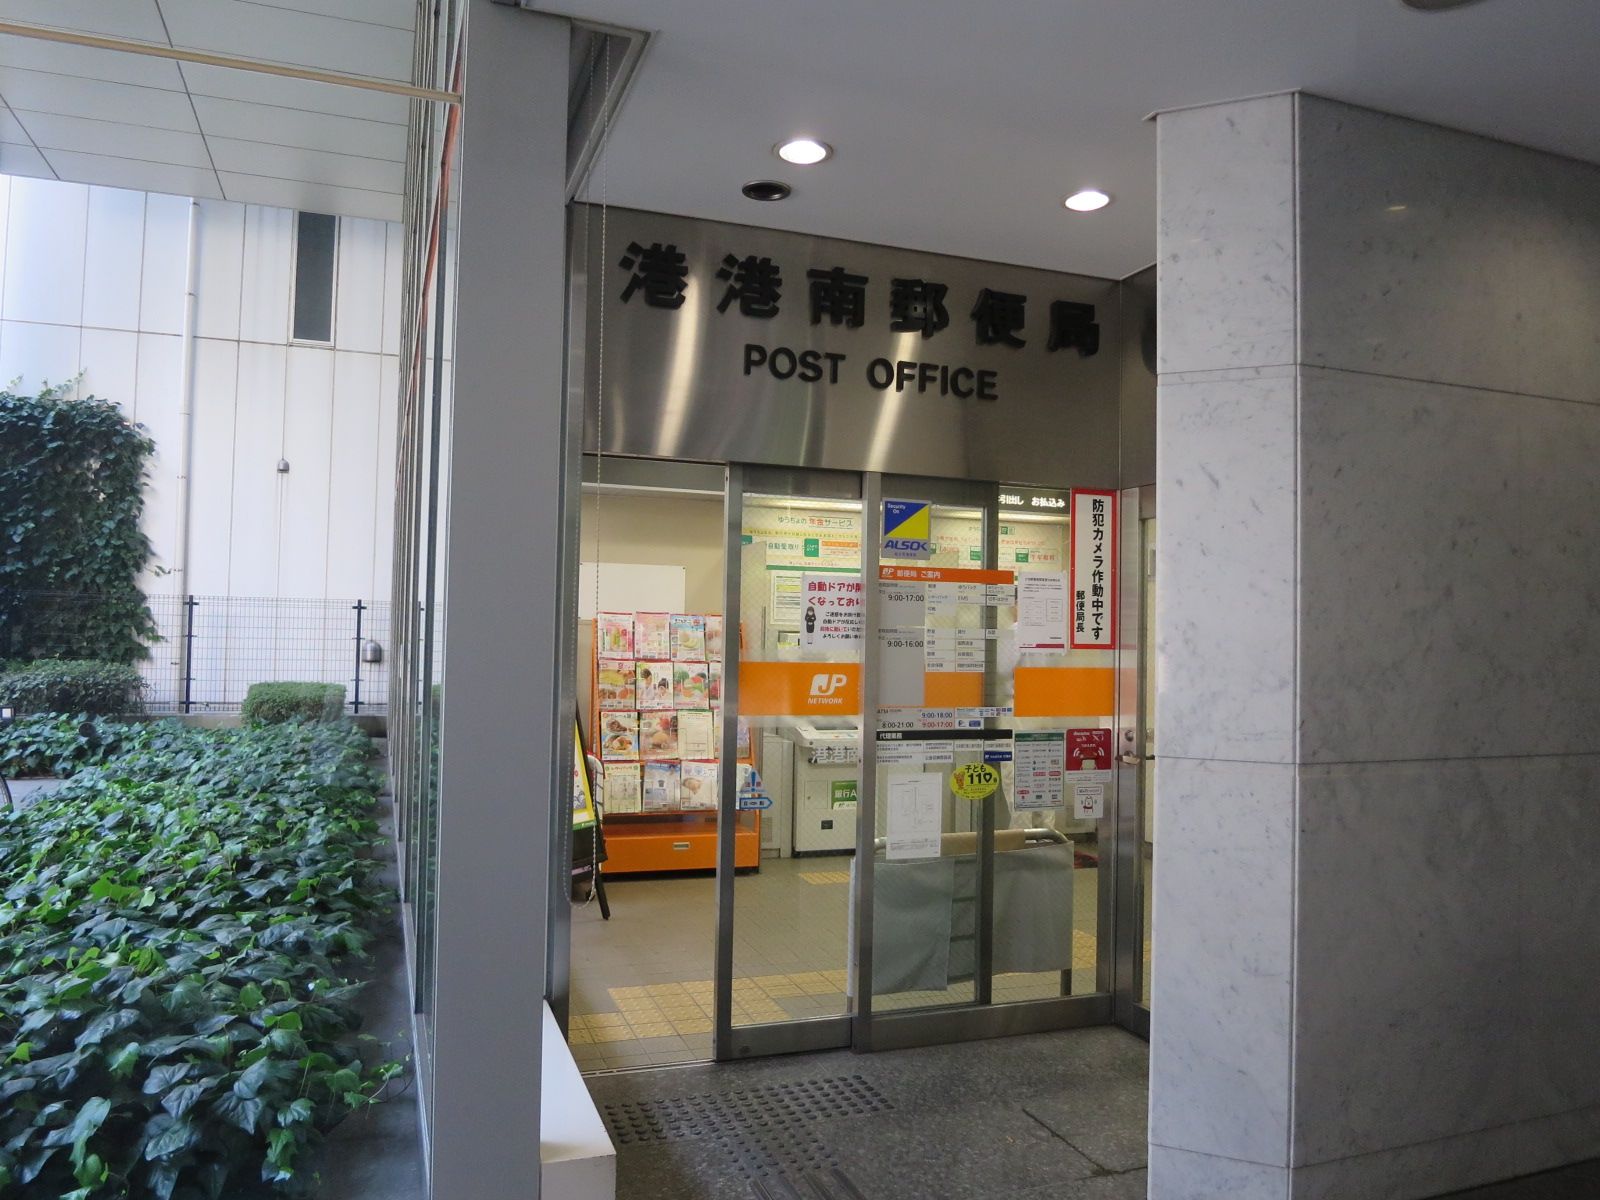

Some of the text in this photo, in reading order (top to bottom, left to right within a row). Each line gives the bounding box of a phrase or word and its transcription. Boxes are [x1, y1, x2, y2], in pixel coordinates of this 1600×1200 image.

[618, 240, 1100, 357] 港港南郵便局
[744, 343, 999, 400] POST OFFICE
[1031, 496, 1065, 508] お払込み
[884, 540, 928, 551] ALSOK
[1091, 499, 1105, 640] 防犯カメラ作動中です
[888, 594, 925, 602] 9:00-17:00
[1076, 590, 1085, 633] 郵便局長
[887, 640, 924, 648] 9:00-16:00
[964, 764, 987, 773] 子ども
